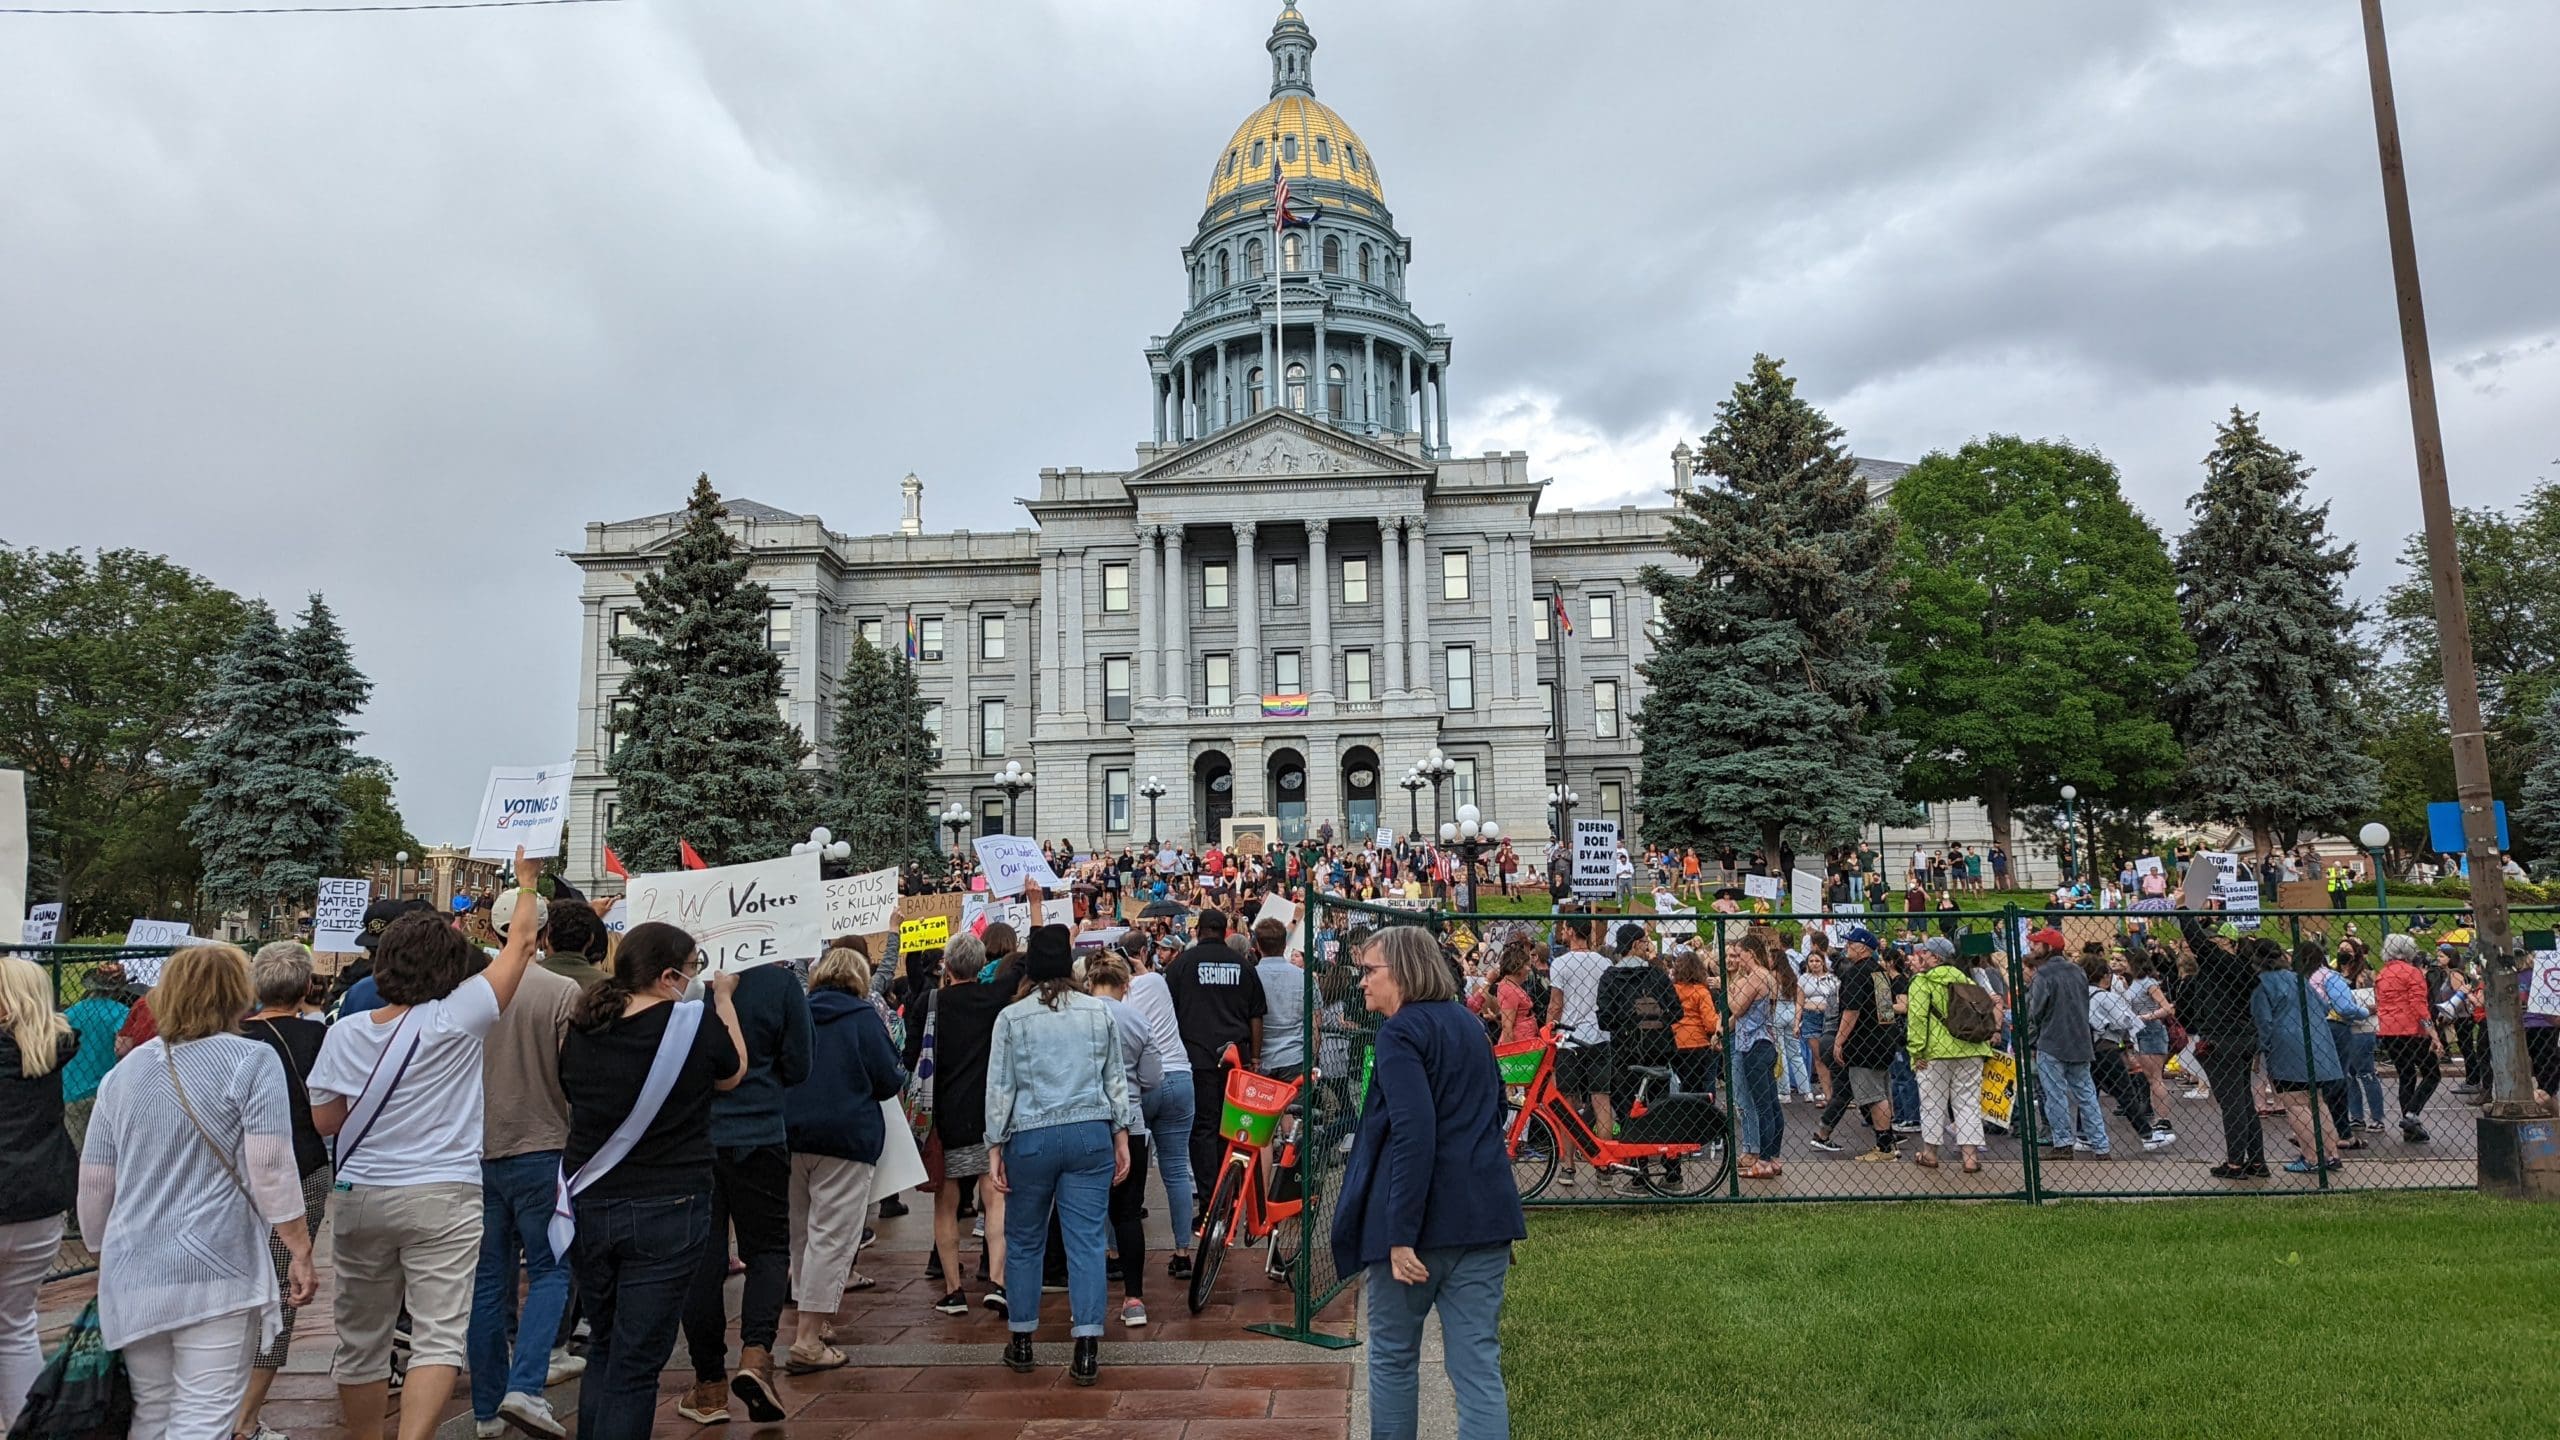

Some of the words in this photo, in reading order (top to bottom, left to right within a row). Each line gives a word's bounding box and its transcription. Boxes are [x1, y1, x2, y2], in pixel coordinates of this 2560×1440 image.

[504, 797, 549, 813] VOTING
[549, 796, 559, 811] IS
[512, 818, 538, 827] people
[1578, 822, 1614, 832] DEFEND
[1584, 836, 1608, 846] ROE!
[1580, 850, 1592, 859] BY
[1593, 850, 1613, 860] ANY
[2207, 856, 2228, 864] STOP
[1001, 862, 1020, 877] Our
[1581, 865, 1610, 874] MEANS
[319, 881, 366, 895] KEEP
[826, 876, 884, 898] SCOTUS
[317, 896, 365, 907] HATRED
[728, 877, 798, 917] Voters
[826, 901, 839, 911] IS
[848, 892, 895, 909] KILLING
[907, 896, 935, 915] BANS
[940, 894, 960, 908] ARE
[318, 908, 340, 917] OUT
[343, 909, 361, 918] OF
[832, 909, 880, 931] WOMEN
[316, 919, 365, 929] POLITICS
[1198, 966, 1241, 985] SECURITY
[1993, 1053, 2012, 1067] OVE
[1981, 1090, 2002, 1104] FIGH
[1988, 1108, 2008, 1122] THIS
